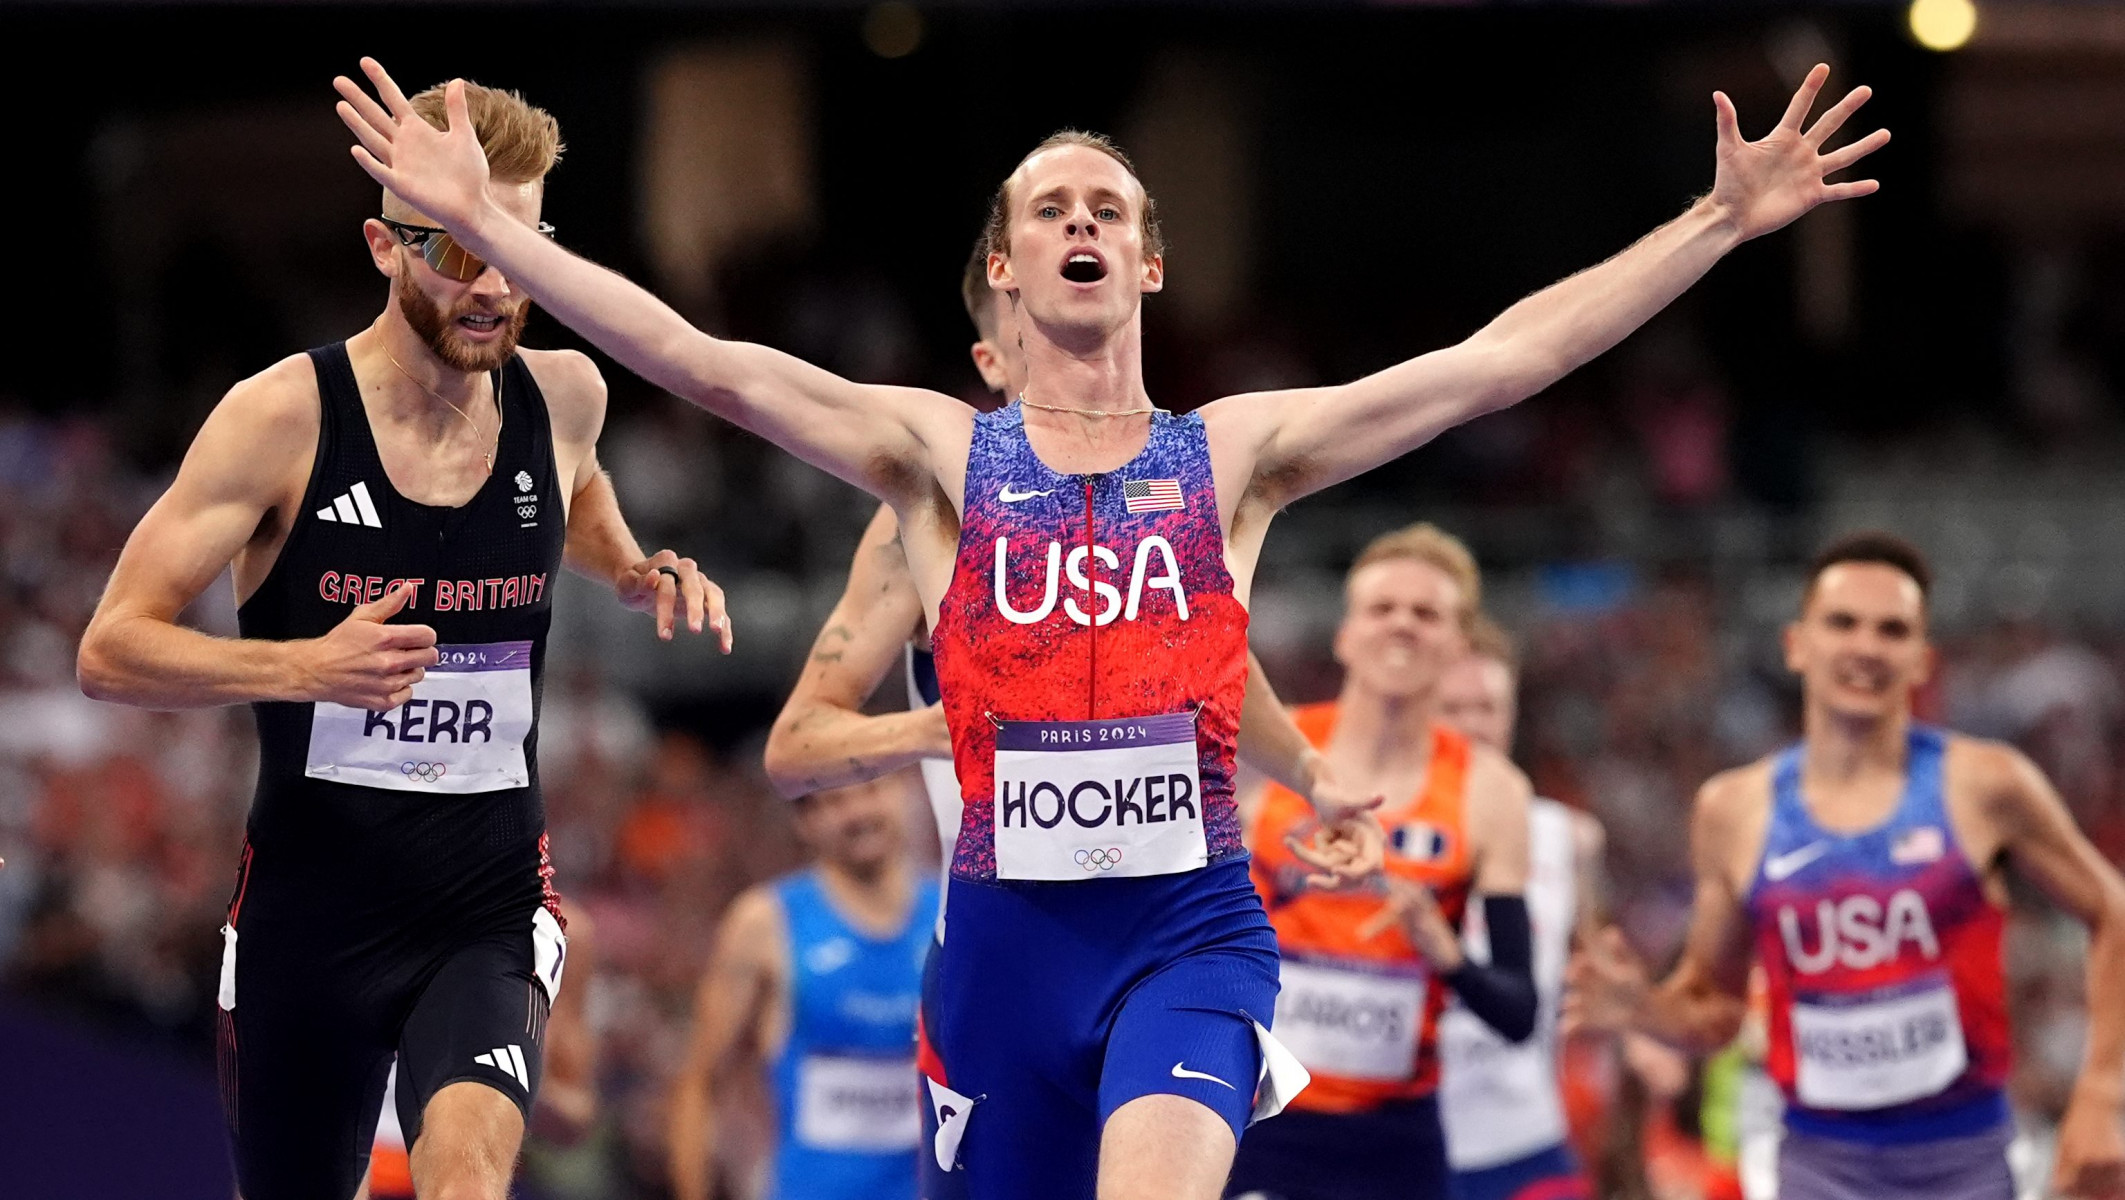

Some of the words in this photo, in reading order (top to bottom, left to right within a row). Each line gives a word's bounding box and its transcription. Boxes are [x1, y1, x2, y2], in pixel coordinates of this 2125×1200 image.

[513, 495, 529, 504] TEAM
[434, 573, 547, 611] BRITAIN
[994, 536, 1190, 626] USA
[440, 652, 487, 665] 2024
[363, 698, 494, 744] KERR
[1041, 729, 1092, 743] PARIS
[1099, 725, 1147, 742] 2024
[1003, 773, 1196, 829] HOCKER
[1776, 889, 1941, 975] USA
